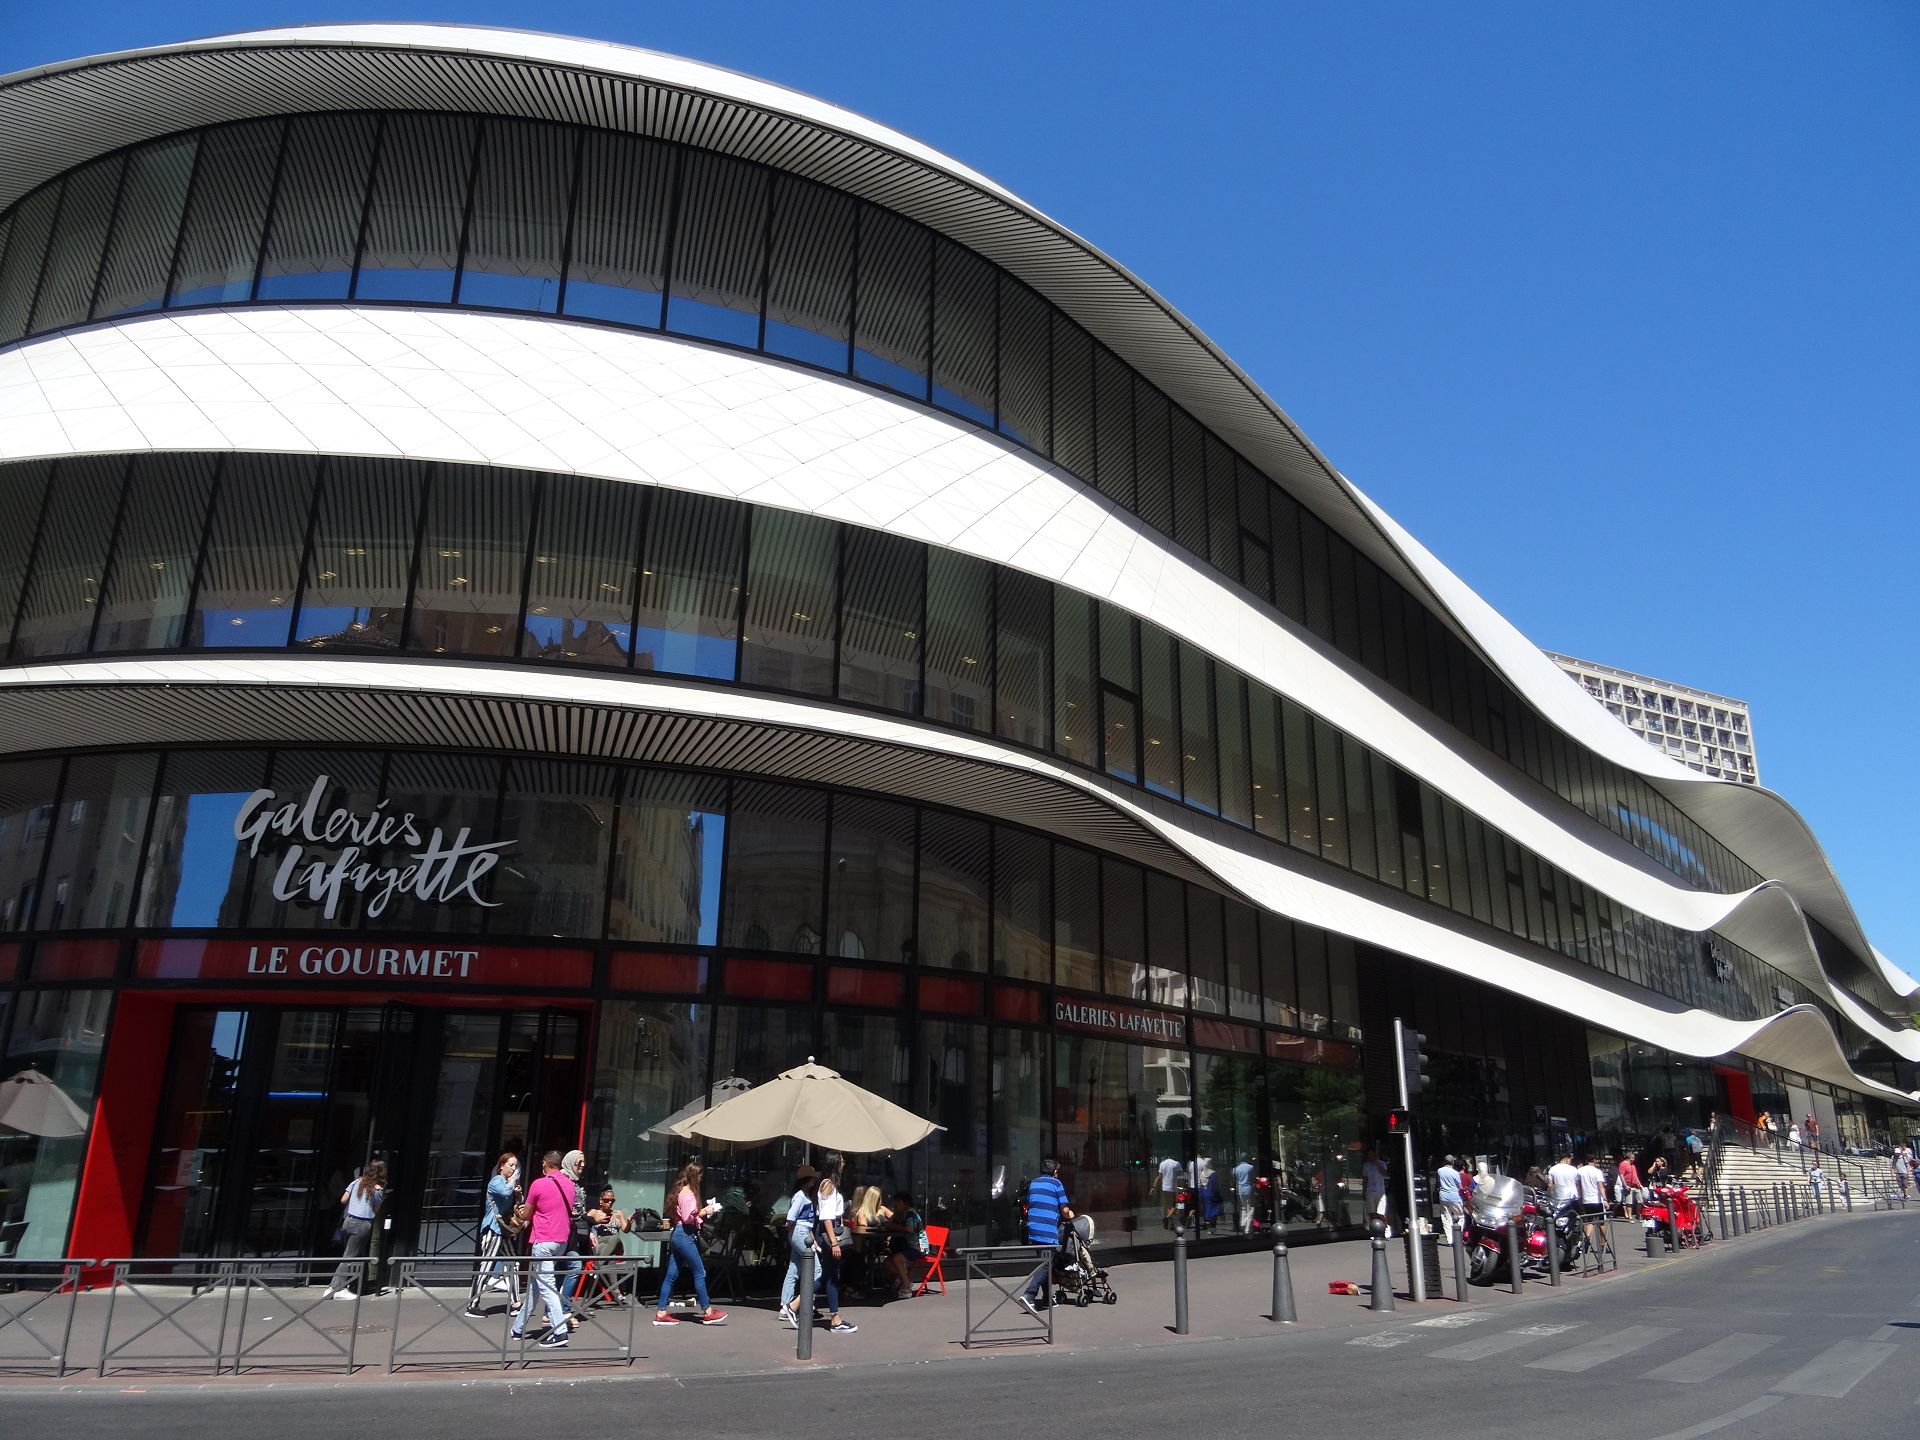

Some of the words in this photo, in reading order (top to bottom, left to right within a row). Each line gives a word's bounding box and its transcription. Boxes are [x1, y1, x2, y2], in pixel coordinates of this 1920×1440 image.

[234, 774, 422, 859] Galeries
[272, 827, 519, 920] Lafayette
[247, 946, 288, 974] LE
[300, 947, 479, 977] GOURMET
[1055, 1002, 1116, 1028] GALERIES
[1120, 1012, 1182, 1038] LAFAYETTE
